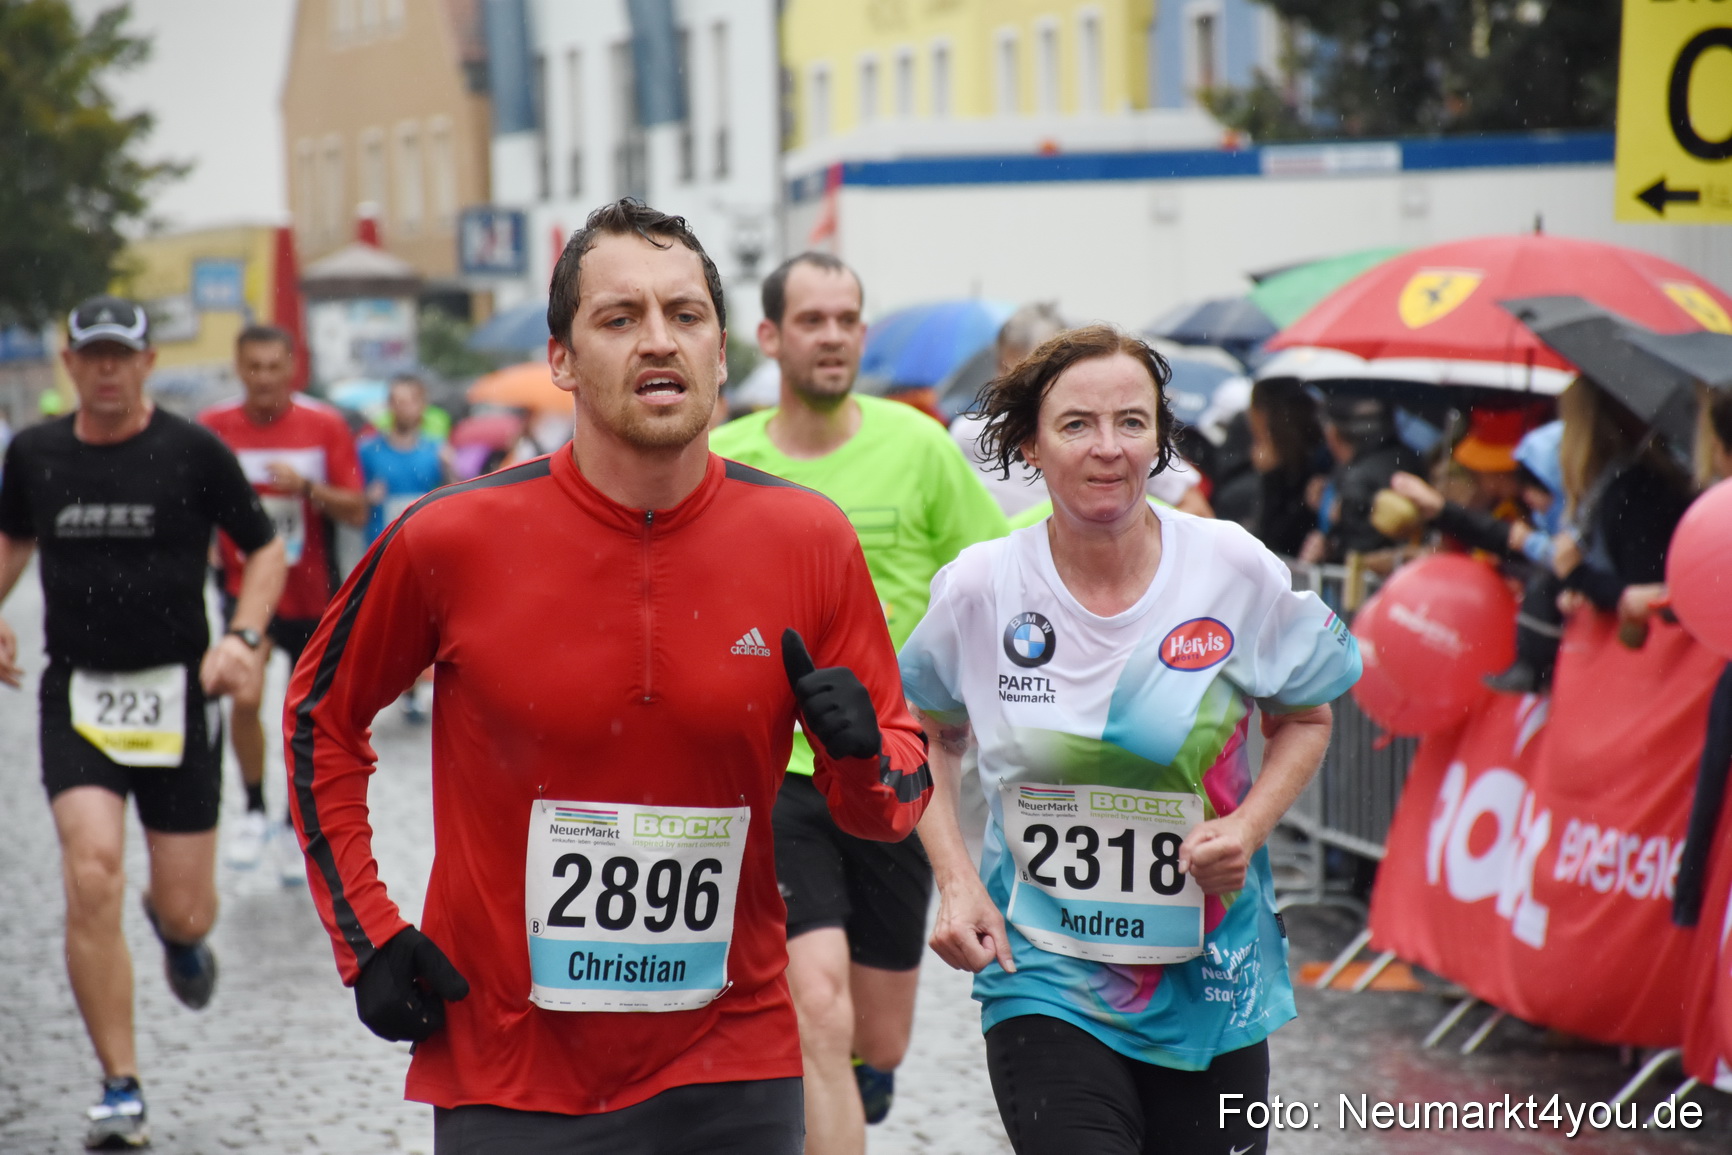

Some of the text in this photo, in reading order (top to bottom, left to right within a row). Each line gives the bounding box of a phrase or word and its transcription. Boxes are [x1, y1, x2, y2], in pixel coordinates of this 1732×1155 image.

[1010, 613, 1053, 634] BMW
[730, 644, 771, 657] adidas
[1170, 631, 1225, 657] Hervis
[998, 674, 1056, 692] PARTL
[97, 690, 160, 726] 223
[998, 690, 1056, 703] Neumarkt
[1017, 798, 1079, 812] NeuerMarkt
[1090, 791, 1185, 818] BOCK
[549, 824, 620, 839] NeuerMarkt
[633, 813, 733, 839] BOCK
[1023, 824, 1186, 896] 2318
[547, 853, 723, 933] 2896
[532, 920, 540, 934] B
[1061, 908, 1145, 939] Andrea
[568, 951, 686, 983] Christian
